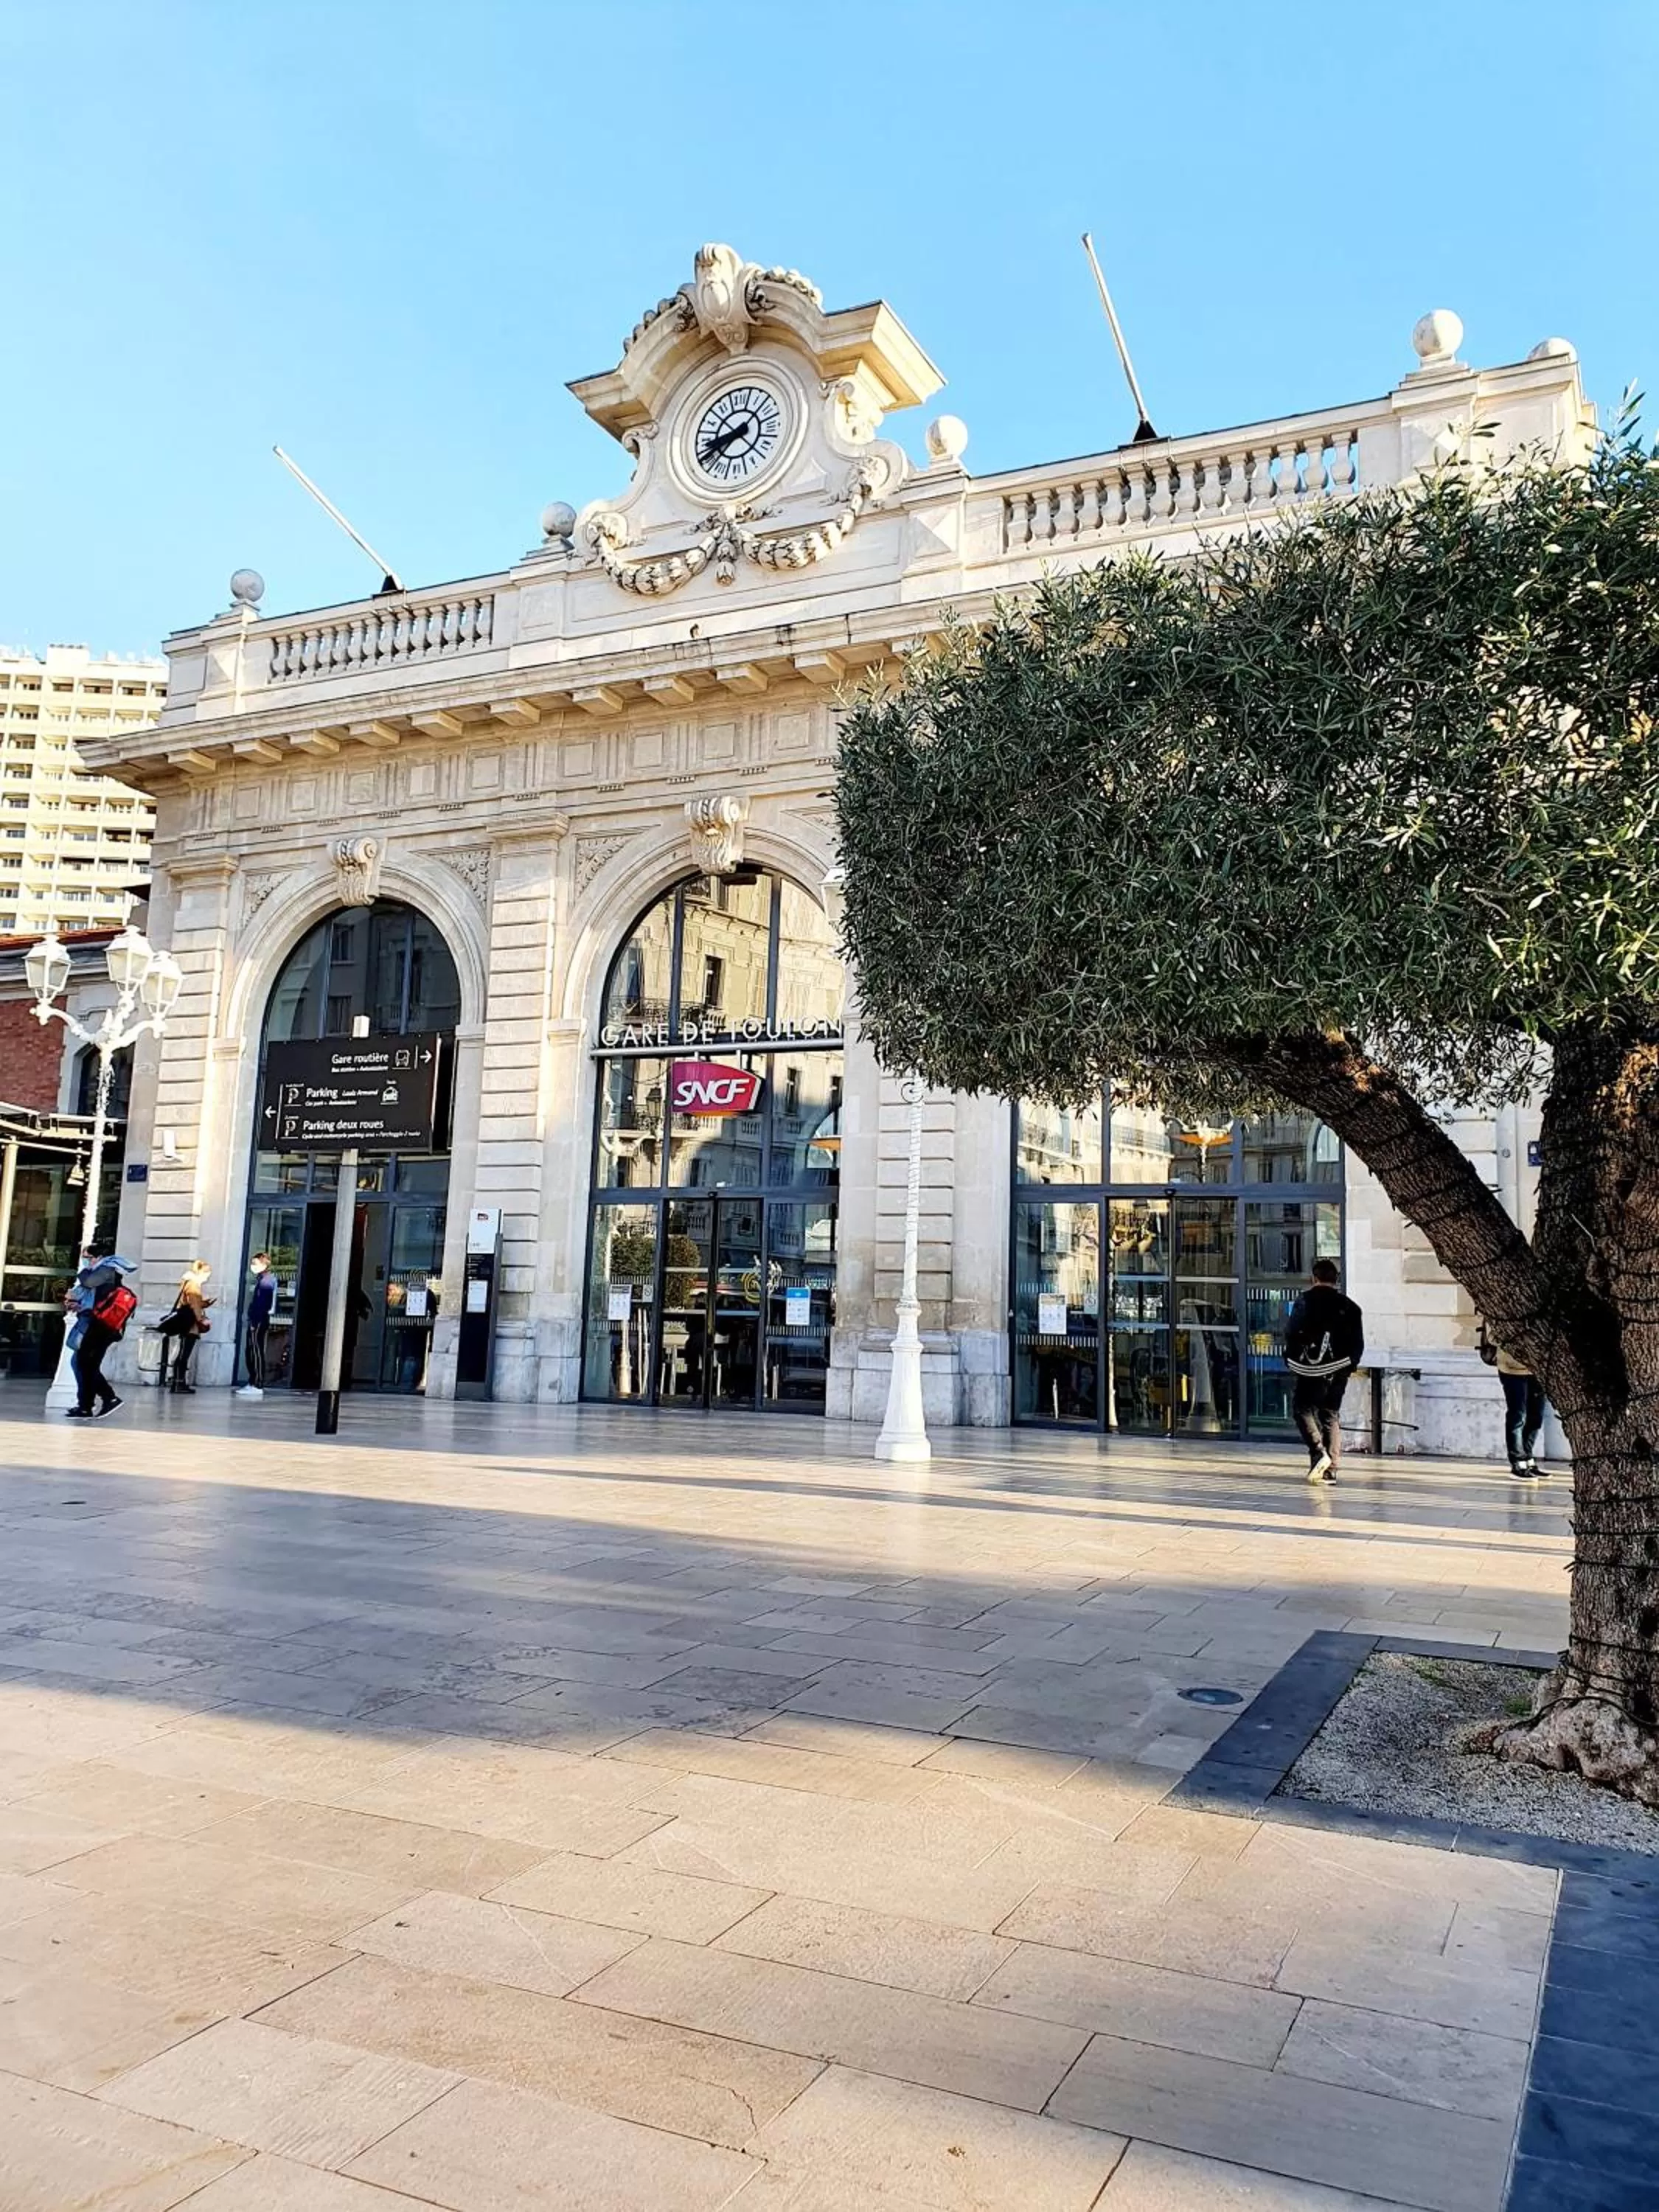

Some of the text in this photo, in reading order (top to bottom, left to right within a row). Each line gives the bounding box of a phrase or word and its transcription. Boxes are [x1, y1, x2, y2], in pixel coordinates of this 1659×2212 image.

[601, 1017, 843, 1046] GARE DE TOULON
[331, 1052, 389, 1064] Gare routière
[306, 1087, 338, 1099] Parking
[673, 1078, 750, 1106] SNCF
[303, 1119, 384, 1132] Parking deux roues
